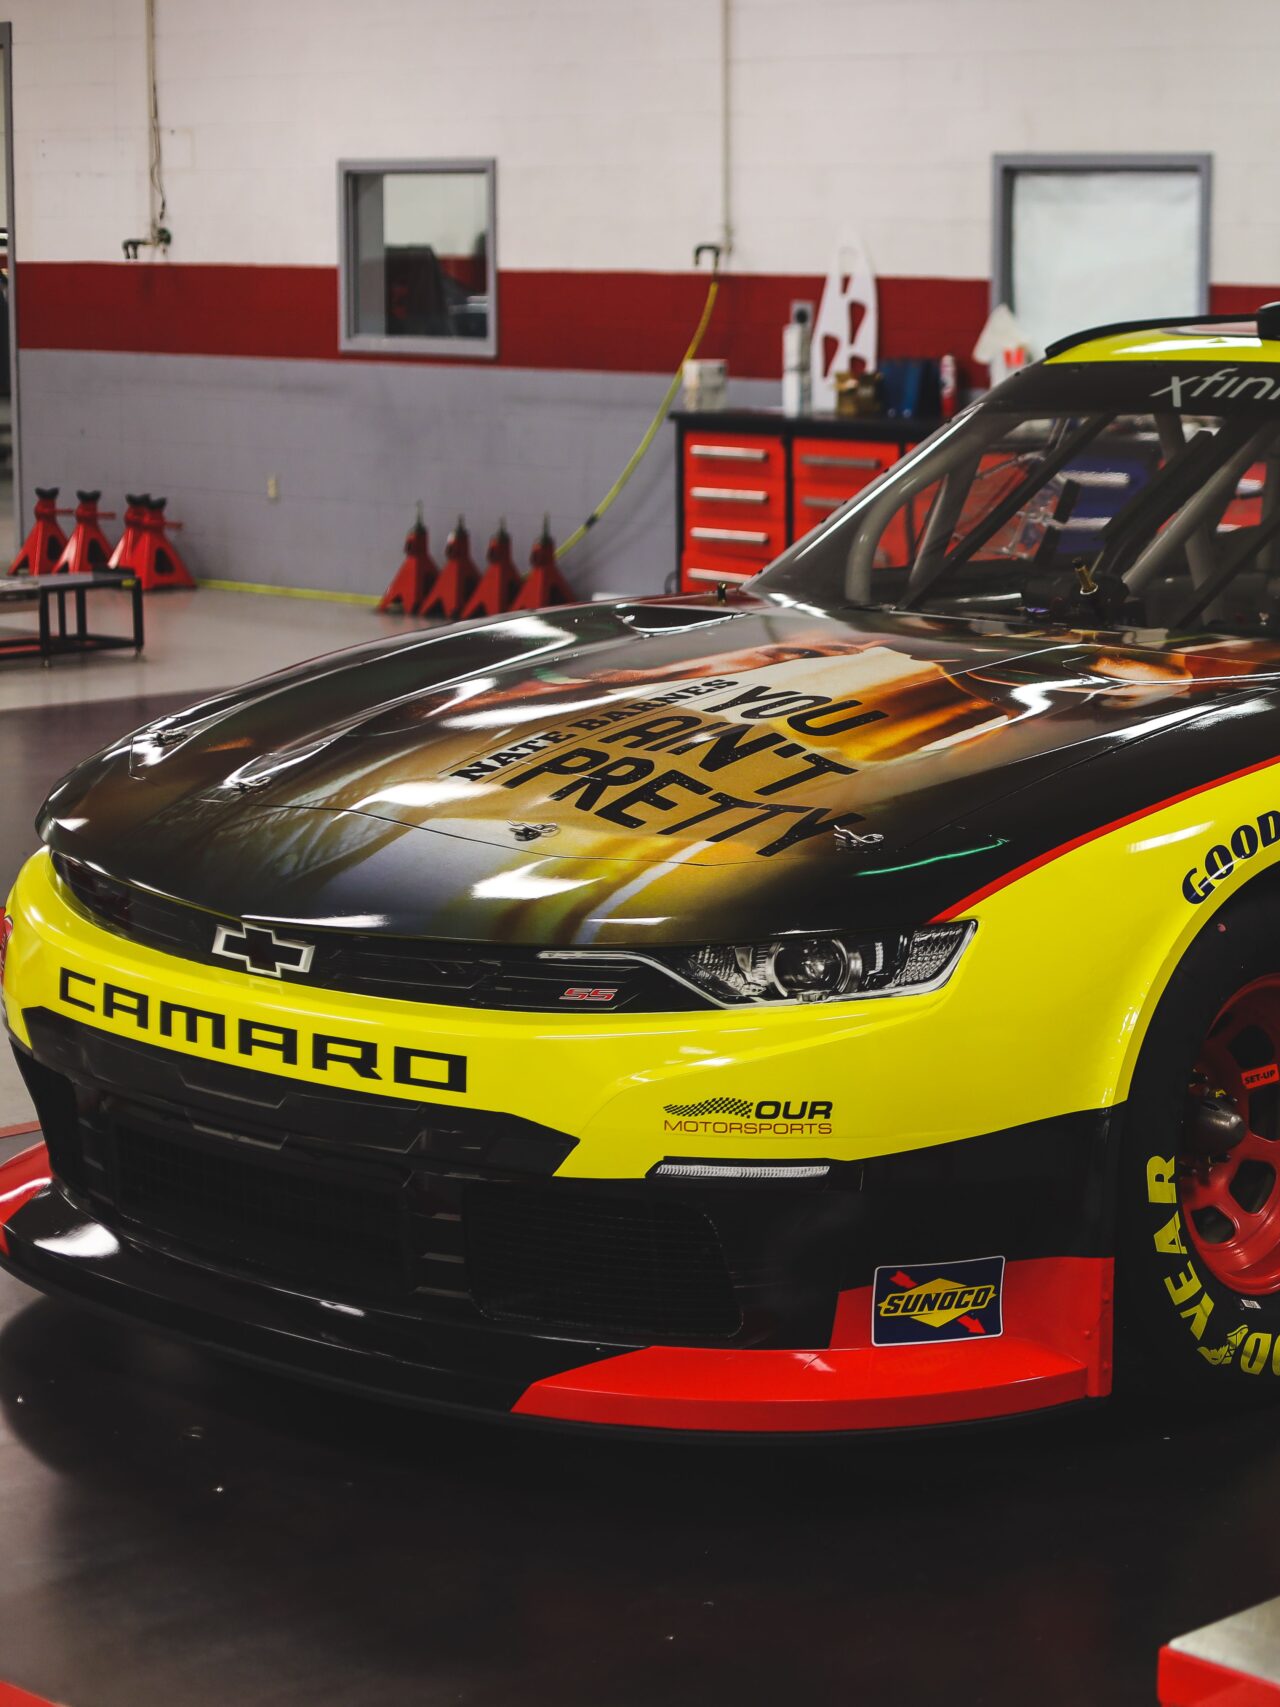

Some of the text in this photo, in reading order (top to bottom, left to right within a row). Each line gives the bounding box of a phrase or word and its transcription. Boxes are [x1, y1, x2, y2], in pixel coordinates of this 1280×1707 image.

[450, 679, 739, 782] NATE BARNES
[707, 686, 889, 737] YOU
[598, 715, 859, 797] AIN'T
[501, 747, 868, 857] PRETTY
[559, 987, 618, 1001] SS
[59, 967, 467, 1093] CAMARO
[1244, 1069, 1276, 1085] SET-UP
[664, 1120, 832, 1135] MOTORSPORTS
[754, 1101, 833, 1119] OUR
[882, 1287, 990, 1314] SUNOCO
